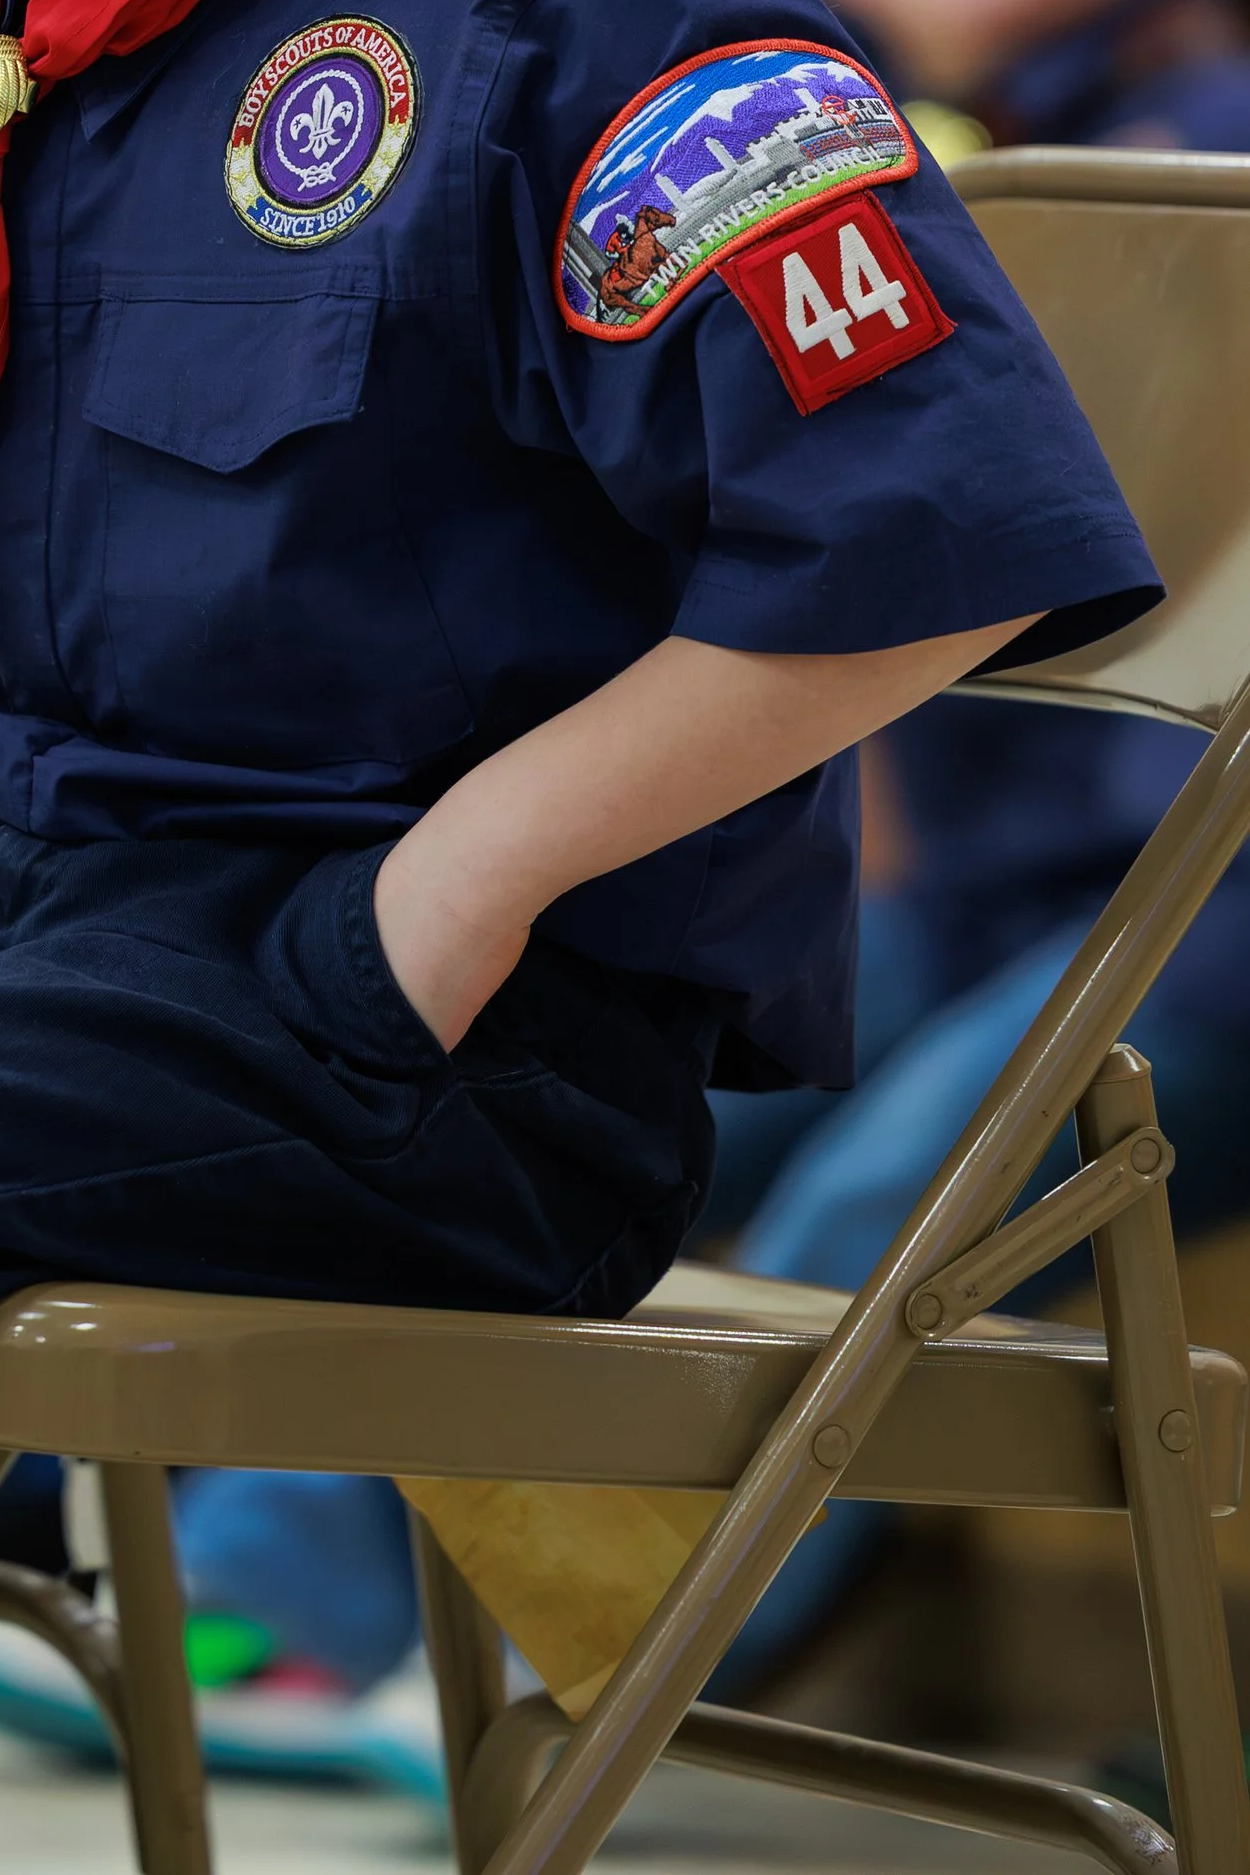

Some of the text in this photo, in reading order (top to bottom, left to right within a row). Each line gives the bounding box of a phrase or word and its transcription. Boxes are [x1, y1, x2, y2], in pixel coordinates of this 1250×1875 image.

[238, 26, 407, 128] BOY SCOUTS OF AMERICA
[260, 196, 356, 238] SINCE 1910
[640, 145, 887, 299] TWIN RIVERS COUNCIL
[782, 222, 910, 360] 44
